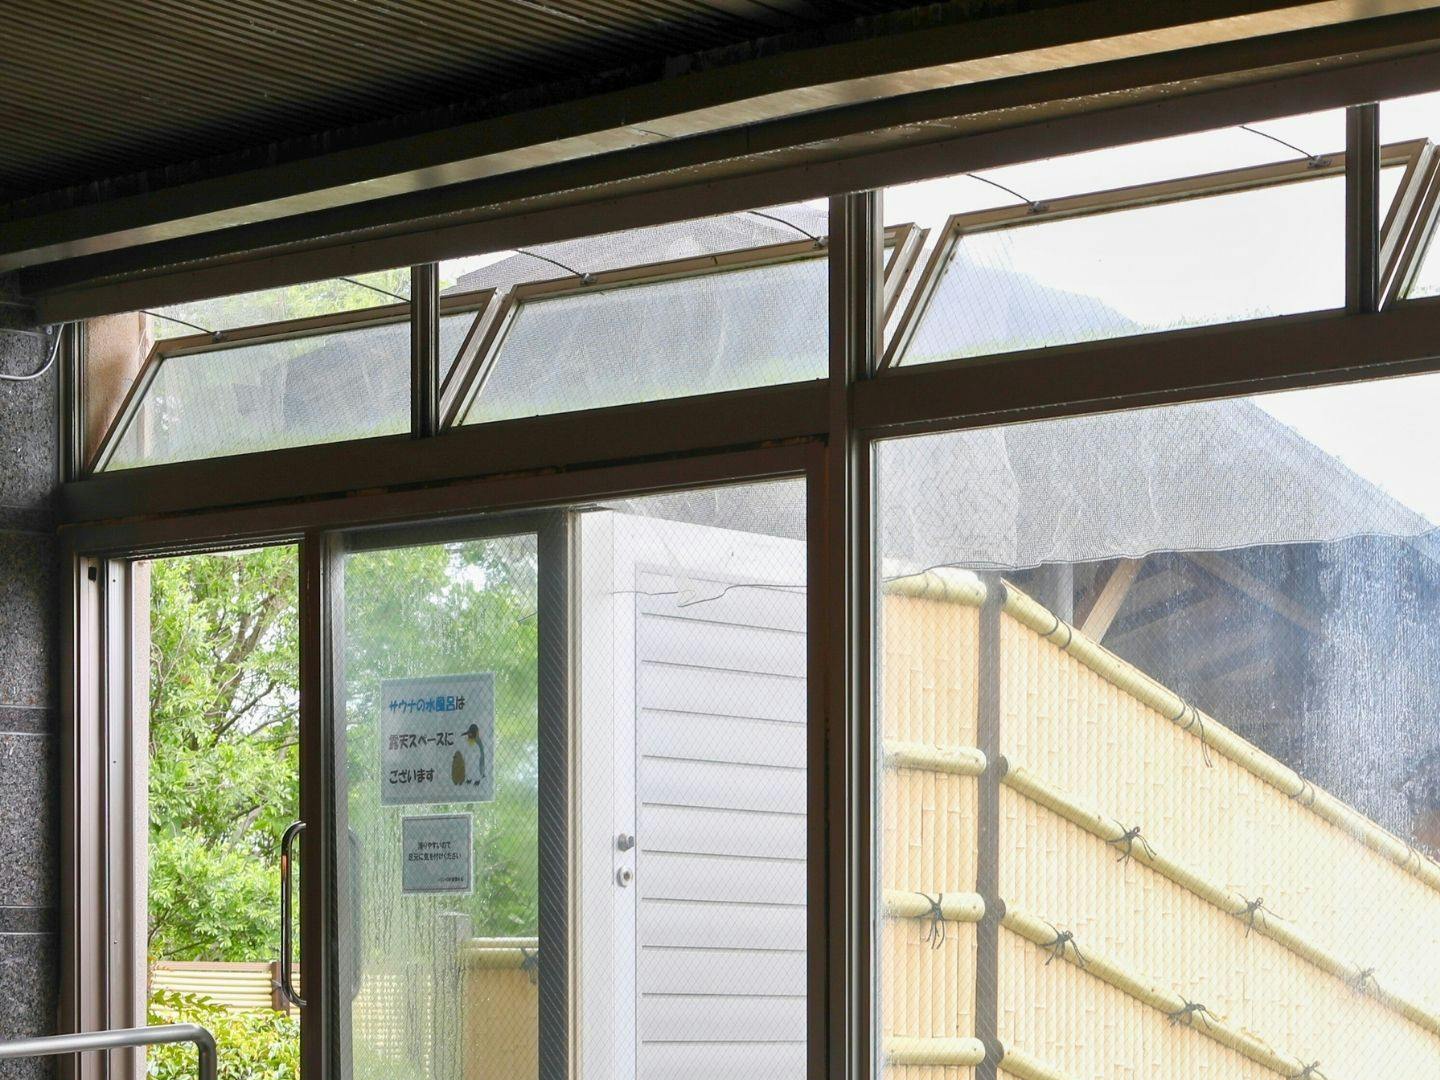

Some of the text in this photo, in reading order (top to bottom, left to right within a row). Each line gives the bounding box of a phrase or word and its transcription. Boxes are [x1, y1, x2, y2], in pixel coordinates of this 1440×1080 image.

[389, 696, 466, 712] サウナの水風呂は
[388, 732, 454, 750] 露天スペースに
[389, 767, 435, 784] ございます
